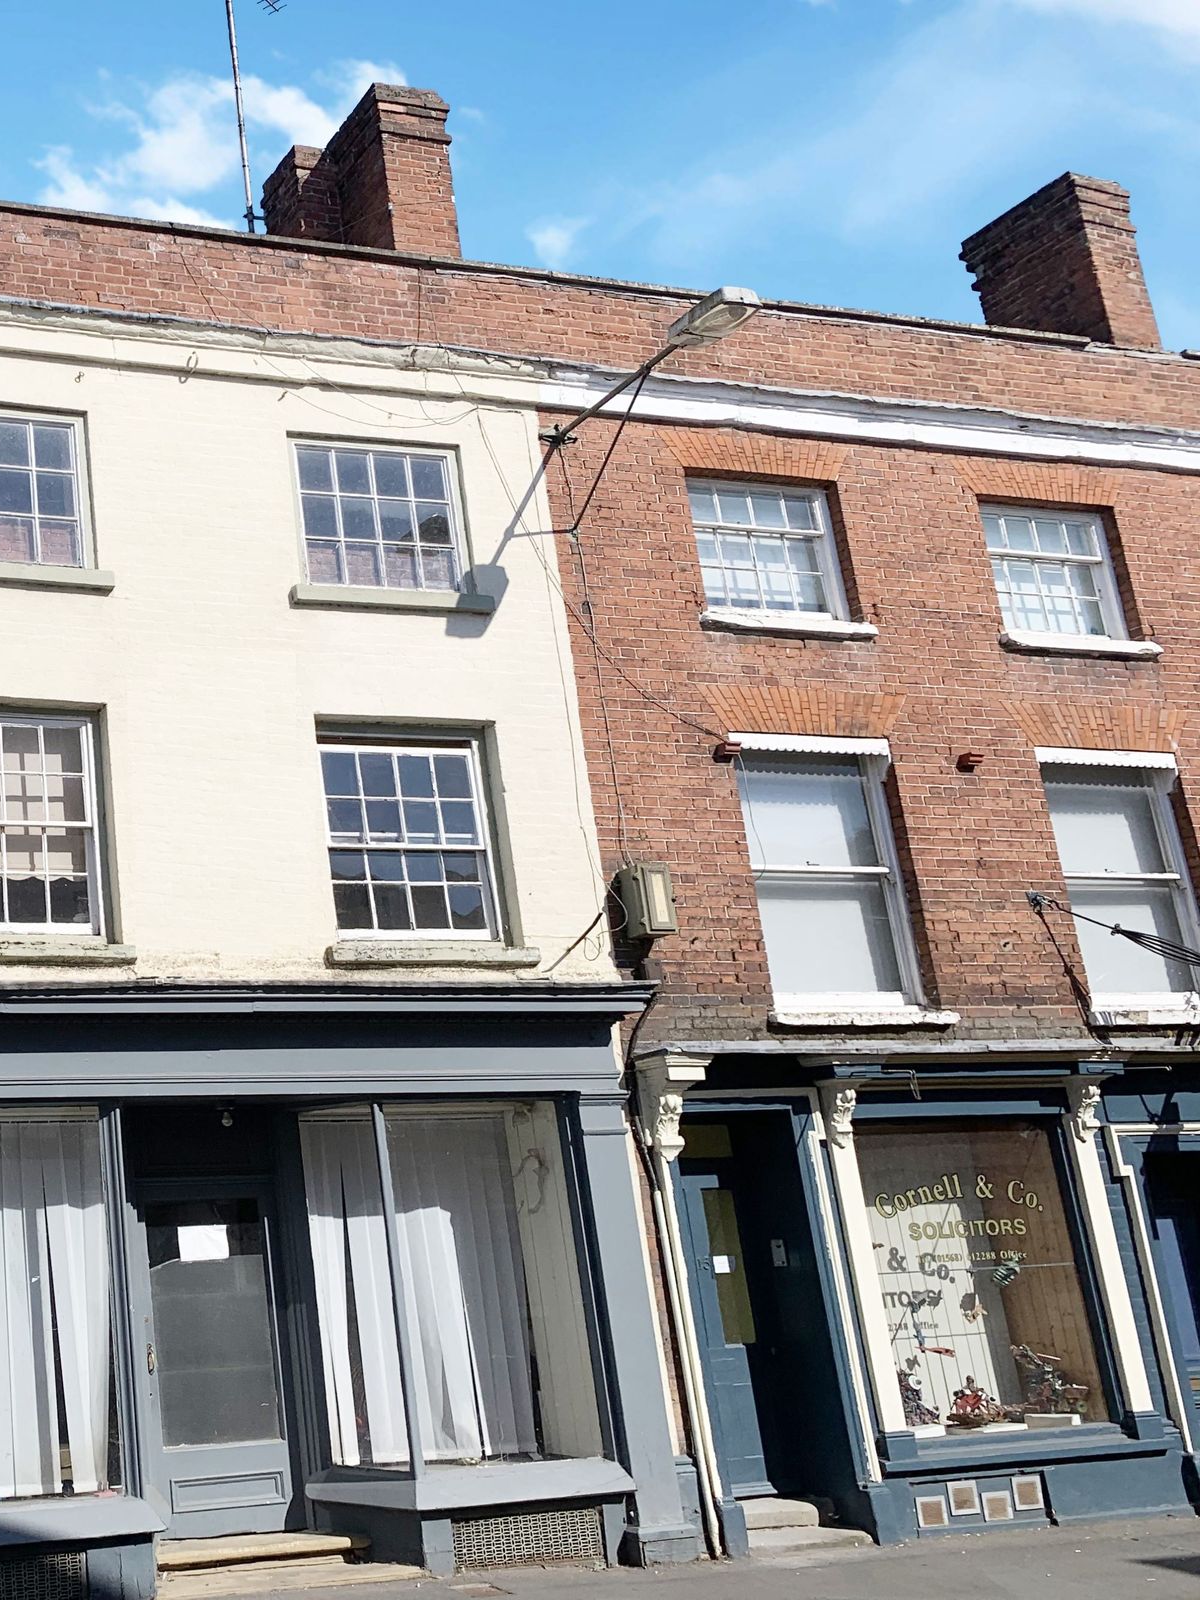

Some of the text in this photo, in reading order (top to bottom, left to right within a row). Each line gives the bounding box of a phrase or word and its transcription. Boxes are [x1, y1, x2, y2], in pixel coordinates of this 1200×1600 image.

[874, 1174, 1043, 1219] Cornell & Co.
[908, 1218, 1027, 1241] SOLICITORS
